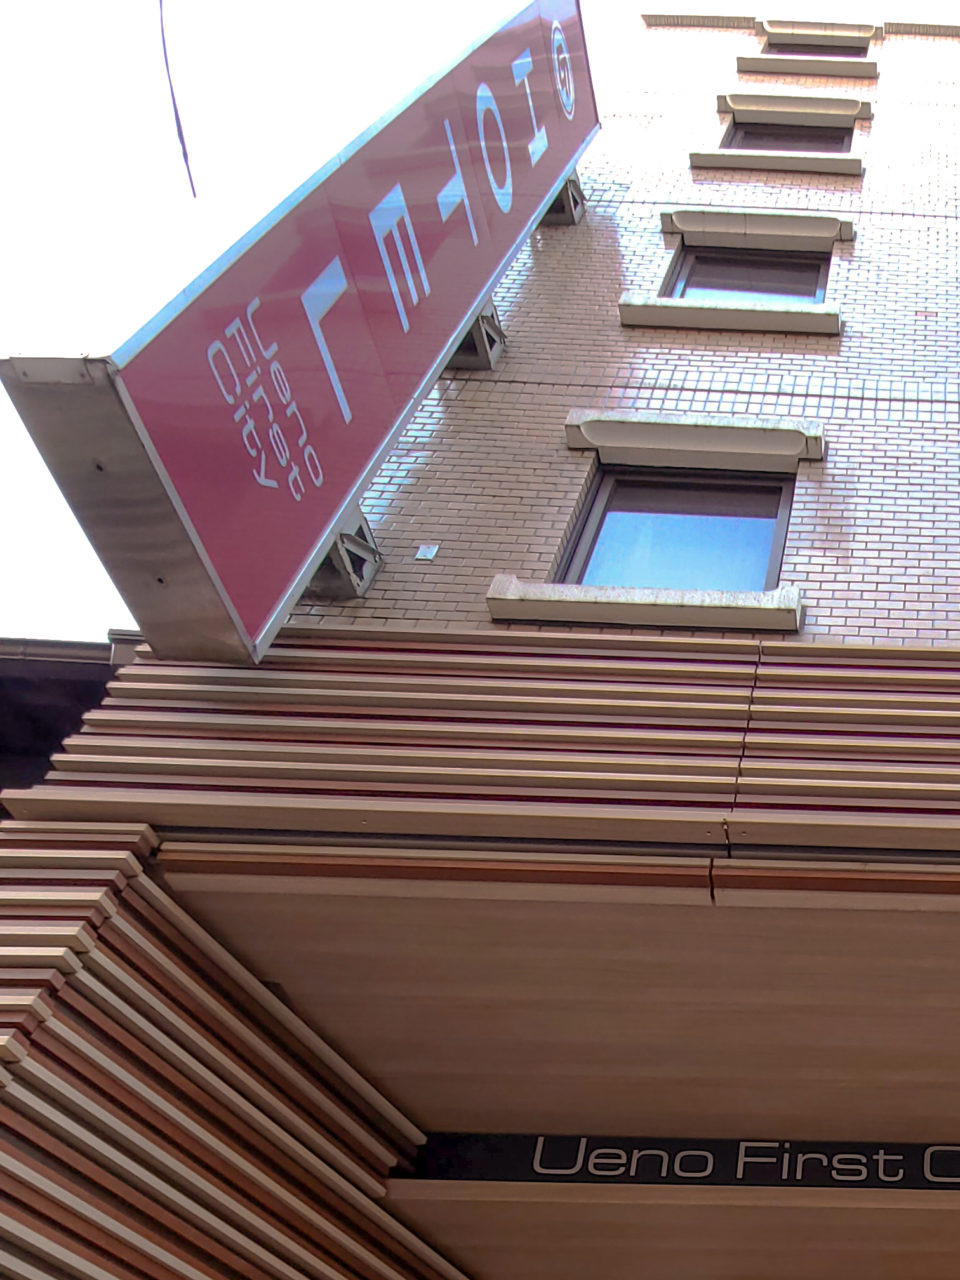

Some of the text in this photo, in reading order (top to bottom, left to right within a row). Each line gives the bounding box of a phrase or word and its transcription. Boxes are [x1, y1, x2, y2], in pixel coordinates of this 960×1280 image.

[300, 47, 549, 425] HOTEL
[207, 339, 279, 489] City
[224, 316, 305, 502] First
[247, 296, 323, 488] Ueno
[532, 1136, 714, 1178] Ueno
[735, 1141, 904, 1182] First
